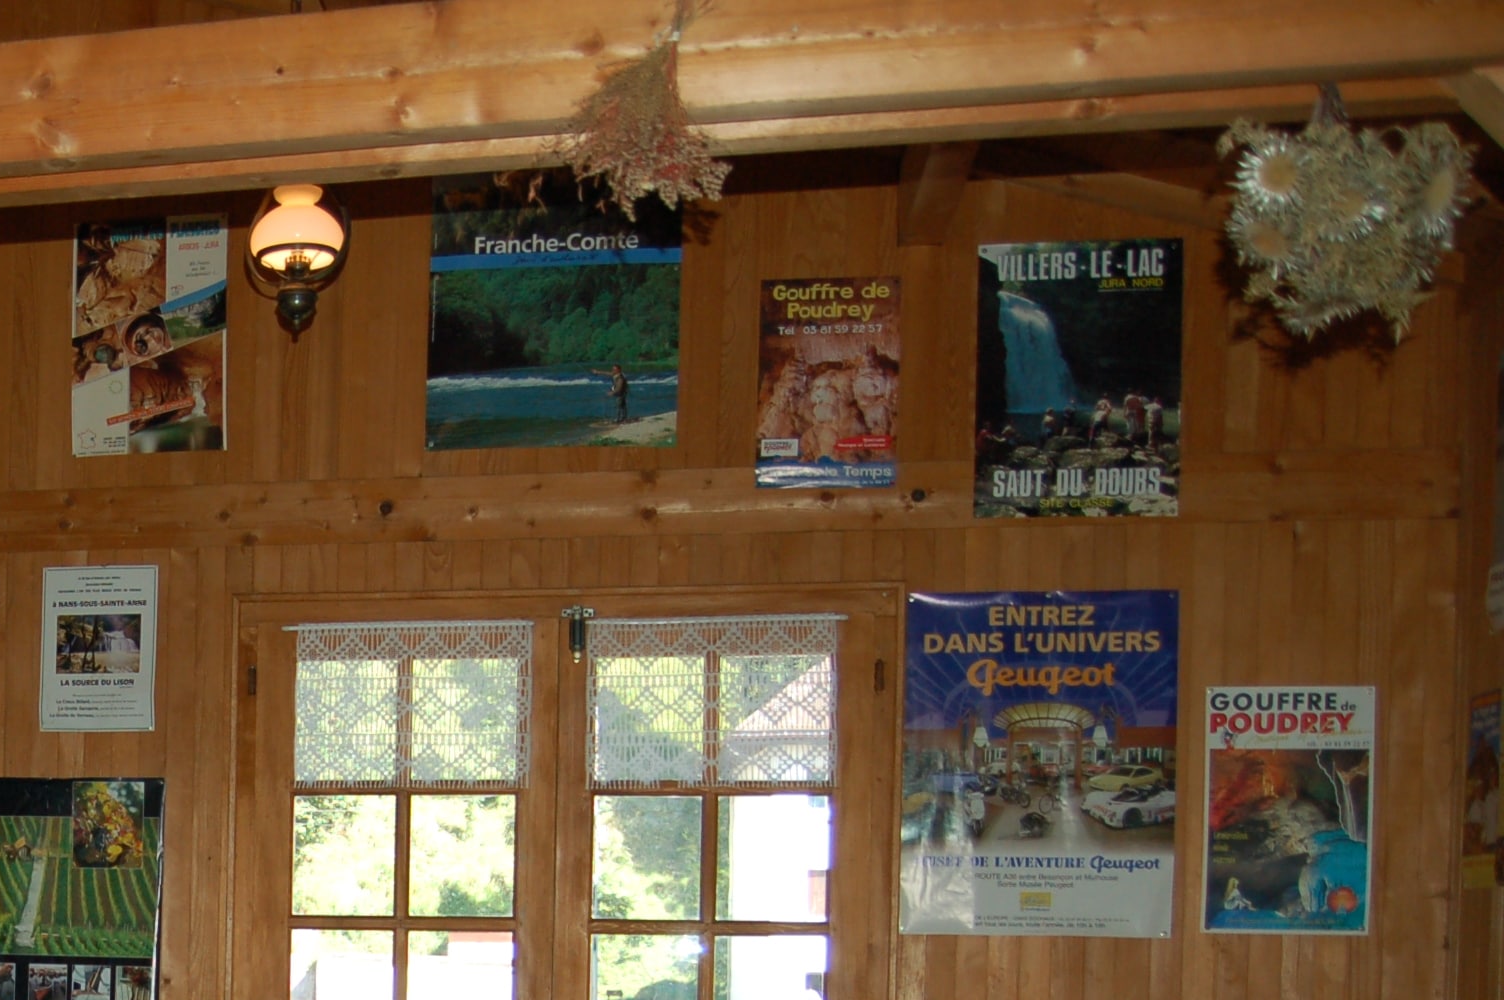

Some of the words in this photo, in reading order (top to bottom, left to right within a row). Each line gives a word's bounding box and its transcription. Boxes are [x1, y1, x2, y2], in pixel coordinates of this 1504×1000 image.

[474, 231, 640, 255] Franche-Comté
[773, 283, 854, 301] Gouffre
[861, 282, 890, 298] de
[1098, 279, 1126, 289] JURA
[1132, 277, 1164, 287] NORD
[787, 302, 875, 321] Poudrey
[852, 325, 865, 333] 22
[843, 465, 892, 480] Temps
[993, 469, 1045, 498] SAUT
[1056, 469, 1083, 496] DU
[1097, 467, 1162, 496] DOUBS
[988, 605, 1095, 627] ENTREZ
[923, 632, 1004, 654] DANS
[1014, 631, 1161, 653] L'UNIVERS
[60, 679, 70, 687] LA
[966, 658, 1116, 697] Peugeot
[1210, 692, 1337, 711] GOUFFRE
[1341, 702, 1357, 711] de
[1210, 712, 1354, 735] POUDREY
[971, 855, 989, 868] DE
[995, 855, 1085, 868] L'AVENTURE
[1089, 855, 1160, 873] Peugeot
